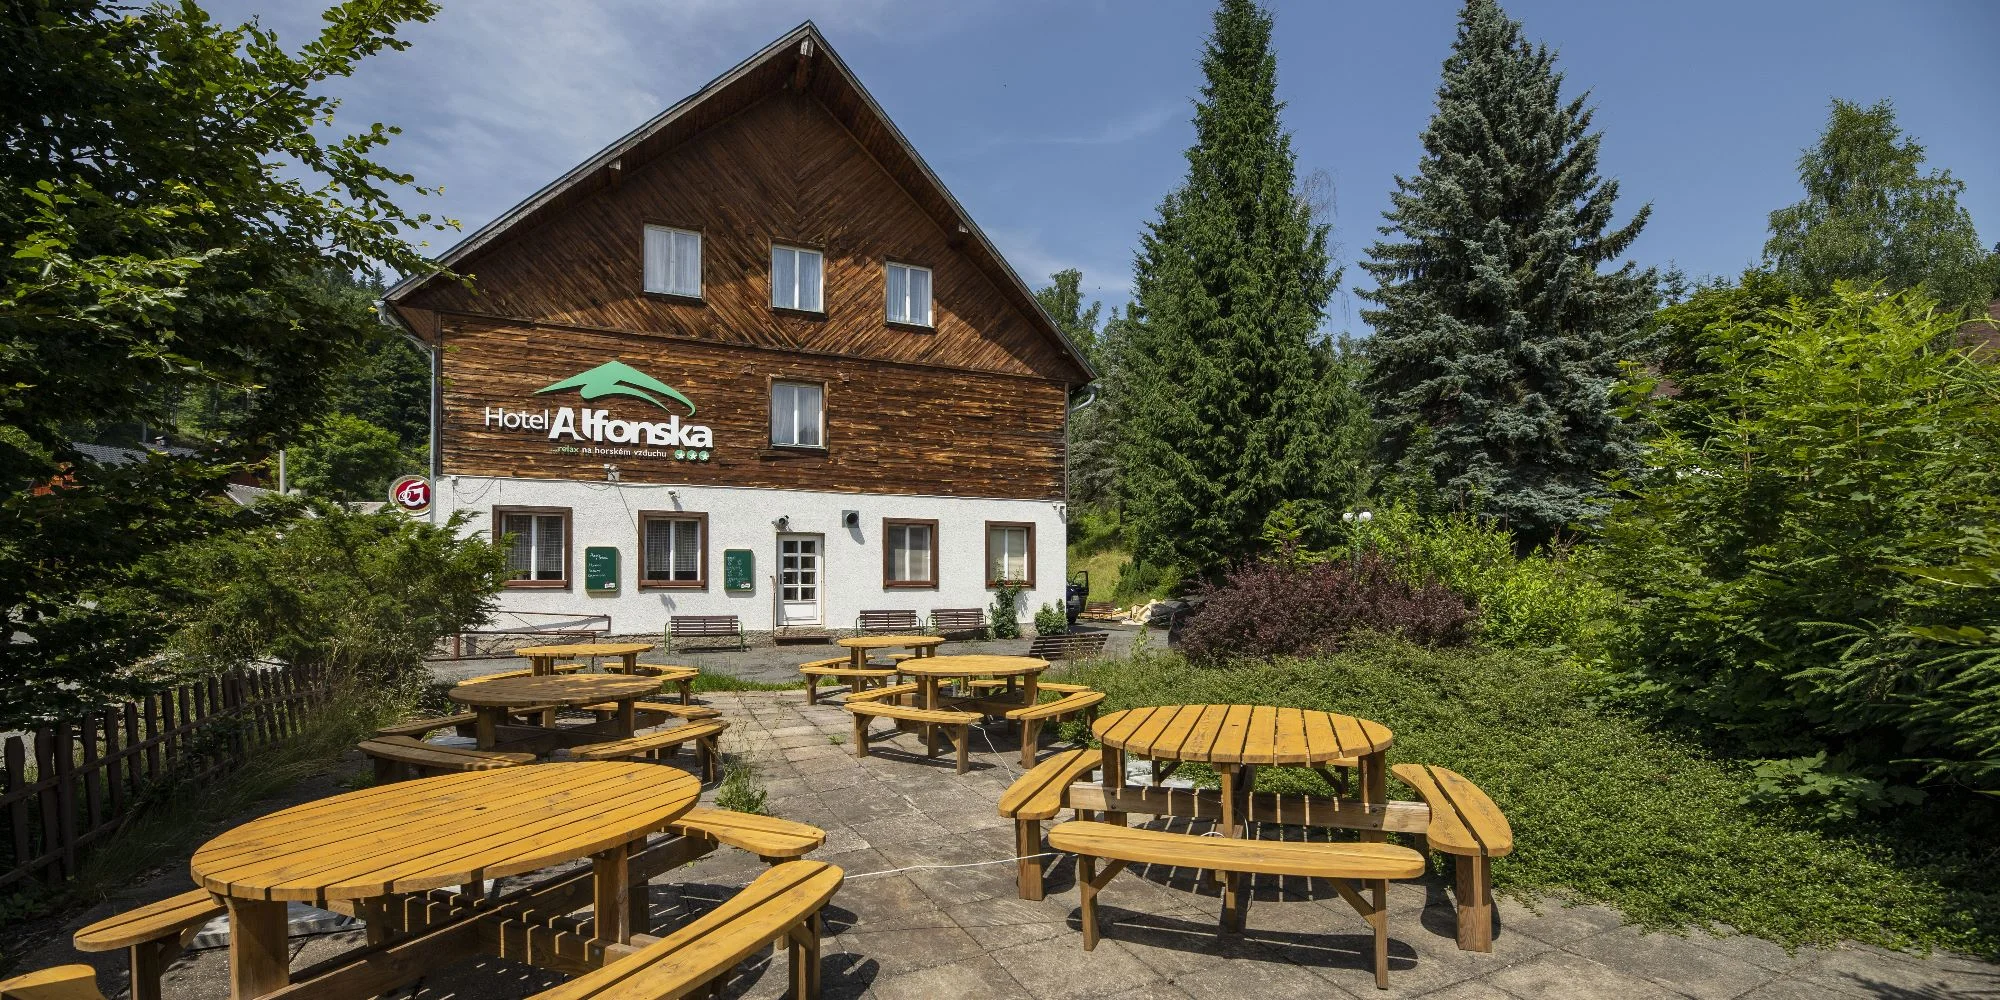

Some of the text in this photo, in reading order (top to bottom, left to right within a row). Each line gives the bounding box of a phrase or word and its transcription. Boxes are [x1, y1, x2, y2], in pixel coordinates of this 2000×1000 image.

[485, 407, 714, 448] Hotel Alfonska
[594, 447, 632, 456] horském
[633, 449, 667, 458] vzduchu
